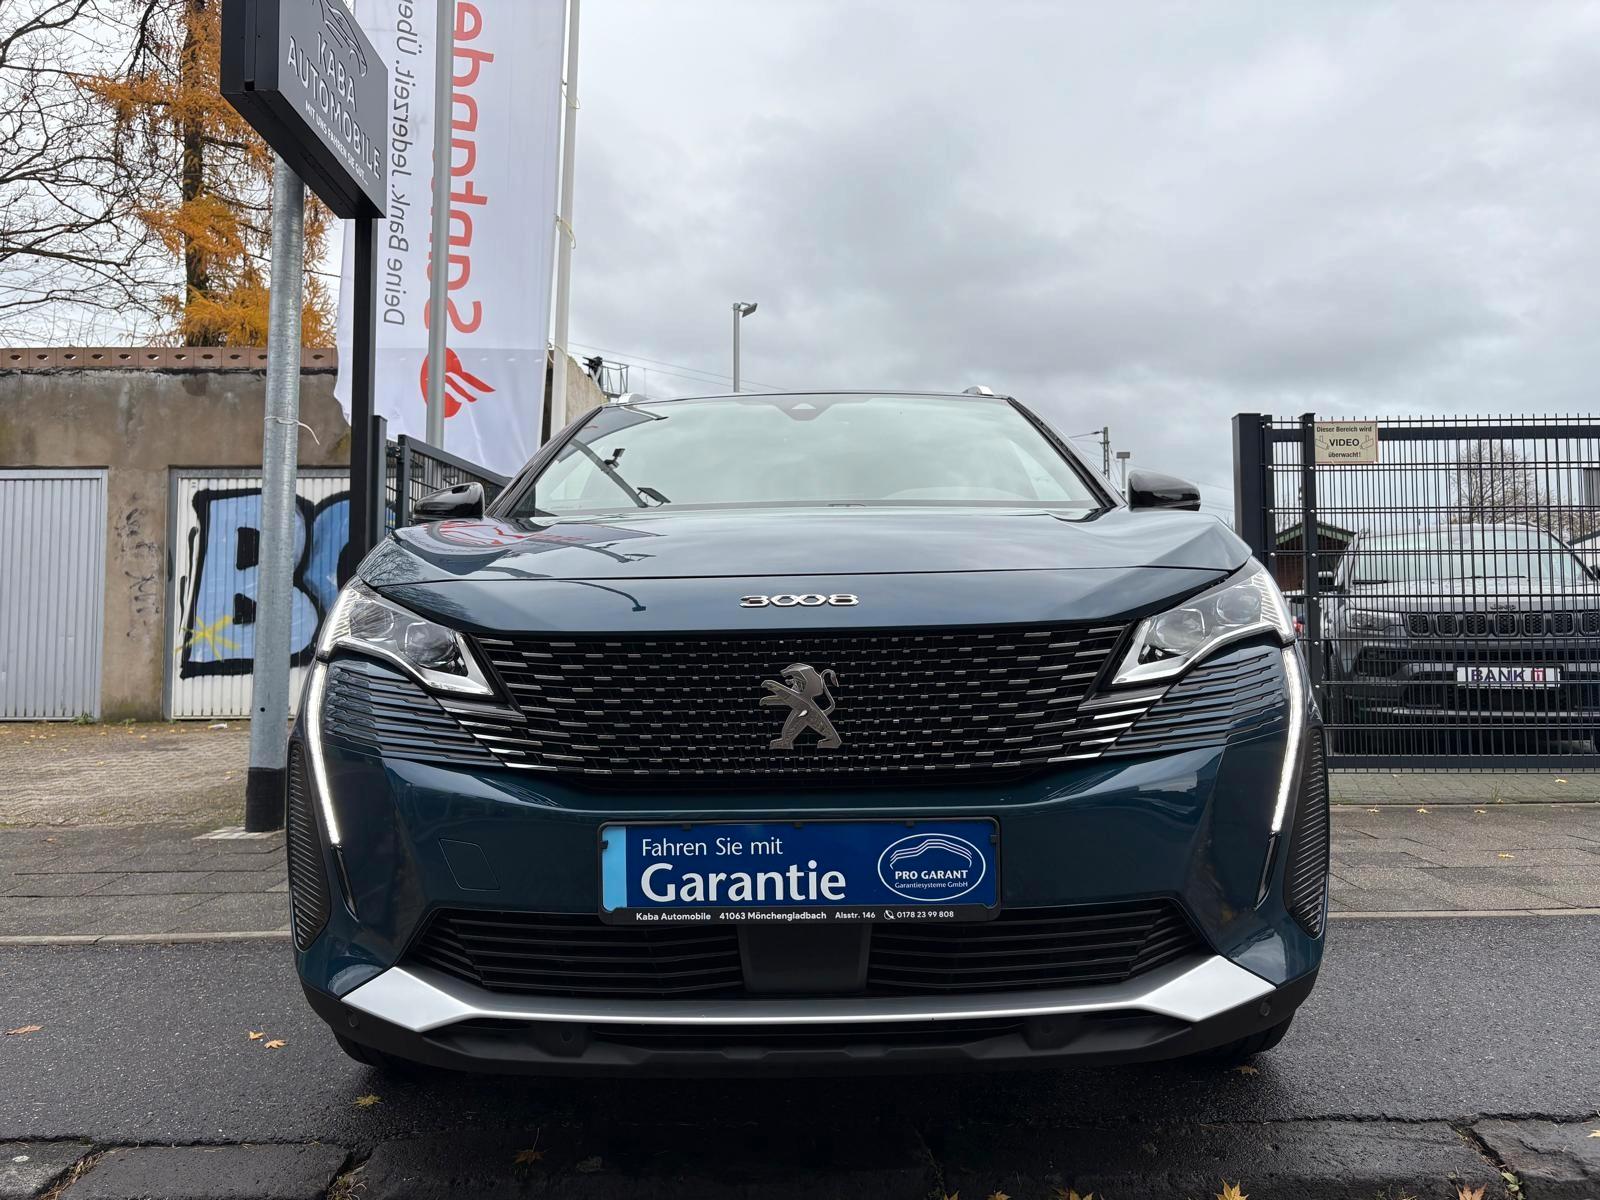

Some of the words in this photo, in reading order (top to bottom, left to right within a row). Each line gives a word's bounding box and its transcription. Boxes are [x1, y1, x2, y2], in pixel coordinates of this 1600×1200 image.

[317, 32, 357, 112] KABA
[287, 35, 380, 180] AUTOMOBILE
[1329, 438, 1360, 446] VIDEO
[739, 593, 860, 608] 3008
[1471, 669, 1526, 682] BANK
[642, 838, 707, 856] Fahren
[715, 837, 743, 856] Sie
[750, 836, 784, 855] mit
[641, 859, 847, 903] Garantie
[895, 871, 918, 880] PRO
[921, 870, 968, 879] GARANT
[636, 912, 659, 920] Kaba
[660, 912, 712, 920] Automobile
[719, 912, 746, 920] 41063
[747, 911, 827, 921] Mönchengladbach
[835, 911, 861, 919] Alsstr.
[938, 910, 955, 918] 808
